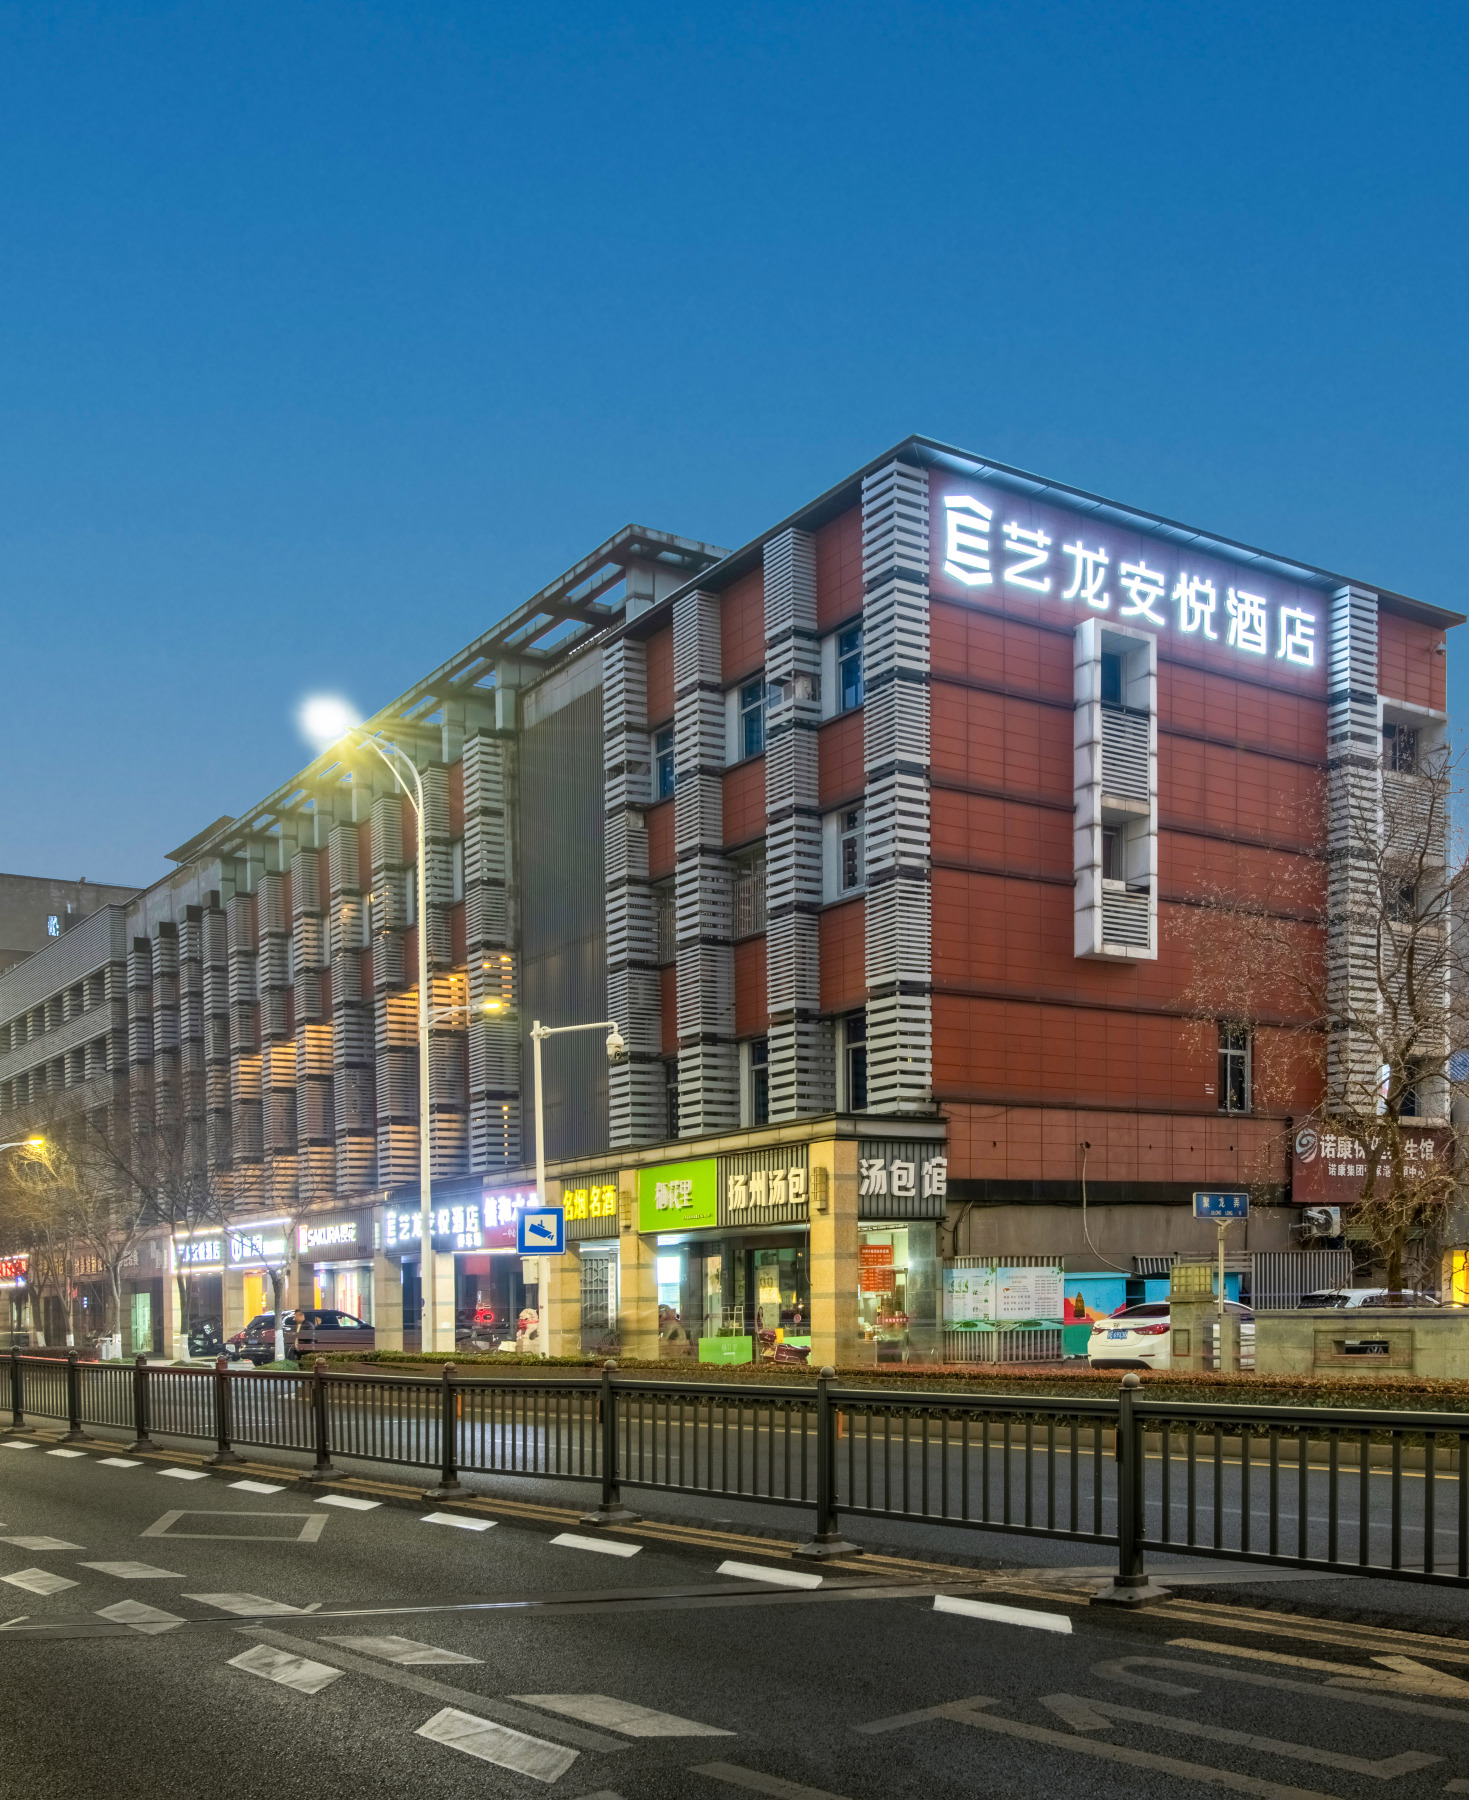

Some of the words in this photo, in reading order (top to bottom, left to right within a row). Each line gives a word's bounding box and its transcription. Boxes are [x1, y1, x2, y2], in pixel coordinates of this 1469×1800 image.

[1003, 521, 1315, 667] 艺龙安悦酒店
[728, 1167, 808, 1210] 扬州汤包
[859, 1157, 947, 1198] 汤包馆
[563, 1185, 616, 1221] 名烟名酒
